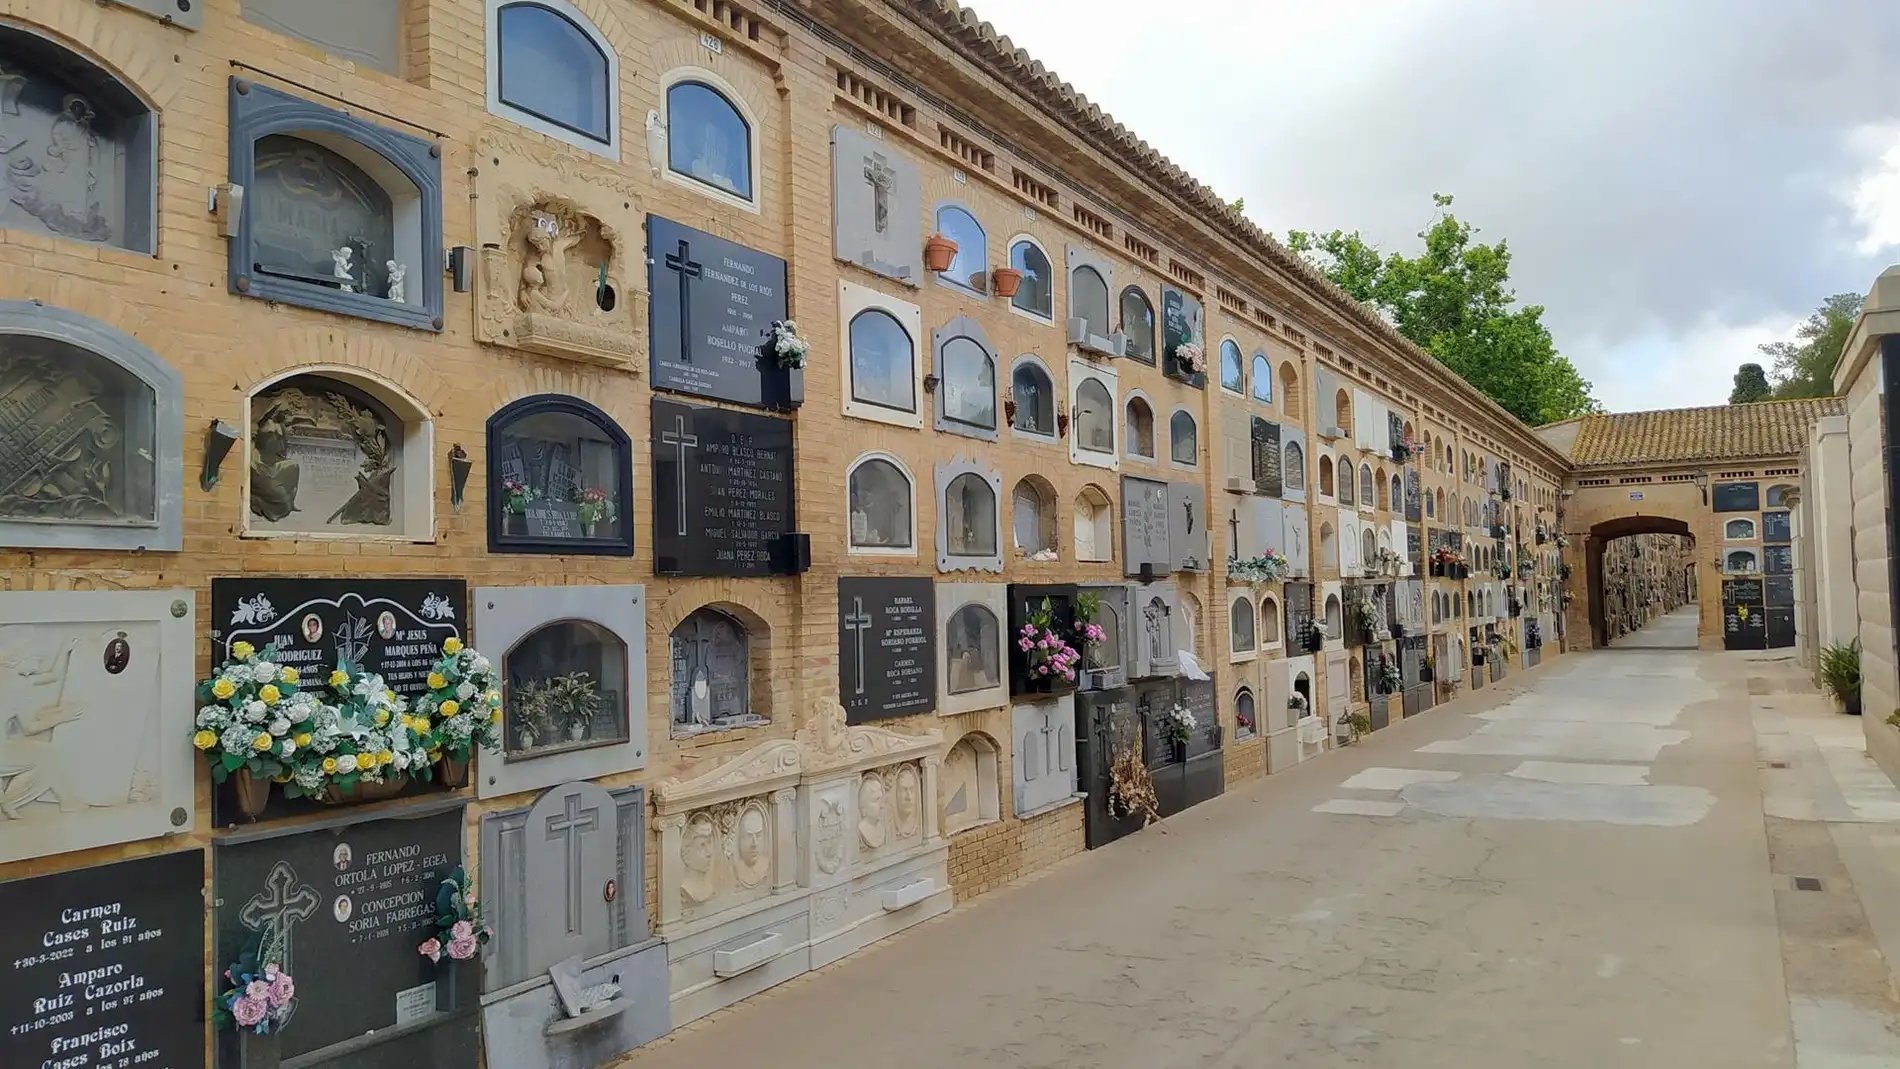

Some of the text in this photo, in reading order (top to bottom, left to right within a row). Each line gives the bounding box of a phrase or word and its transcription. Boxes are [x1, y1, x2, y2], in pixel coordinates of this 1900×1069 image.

[723, 257, 755, 275] FERNANDO
[704, 267, 739, 286] FERNANDEZ
[731, 292, 749, 306] PEREZ
[707, 335, 736, 351] ROSELLO
[731, 446, 754, 458] BLASCO
[727, 467, 756, 479] MARTINEZ
[728, 487, 747, 499] PEREZ
[727, 509, 757, 520] MARTINEZ
[736, 550, 754, 561] PEREZ
[274, 634, 294, 646] JUAN
[407, 629, 427, 641] JESUS
[893, 627, 922, 636] ESPERANZA
[276, 649, 323, 663] RODRIGUEZ
[384, 642, 437, 658] MARQUES PEÑA
[398, 671, 413, 680] HIJOS
[366, 844, 421, 866] FERNANDO
[335, 868, 378, 888] ORTOLA
[384, 860, 415, 877] LOPEZ
[423, 854, 448, 869] EGEA
[362, 889, 425, 915] CONCEPCION
[61, 902, 121, 924] Carmen
[349, 901, 437, 934] SORIA FABREGAS
[43, 916, 137, 947] Cases Ruiz
[85, 943, 93, 954] a
[101, 938, 117, 950] los
[122, 935, 132, 945] 91
[138, 928, 162, 942] años
[58, 963, 123, 988] Amparo
[33, 975, 144, 1015] Ruiz Cazorla
[86, 1006, 94, 1016] a
[101, 1000, 118, 1012] los
[123, 995, 134, 1005] 97
[140, 987, 164, 1002] años
[50, 1023, 129, 1055] Francisco
[99, 1038, 136, 1060] Boix
